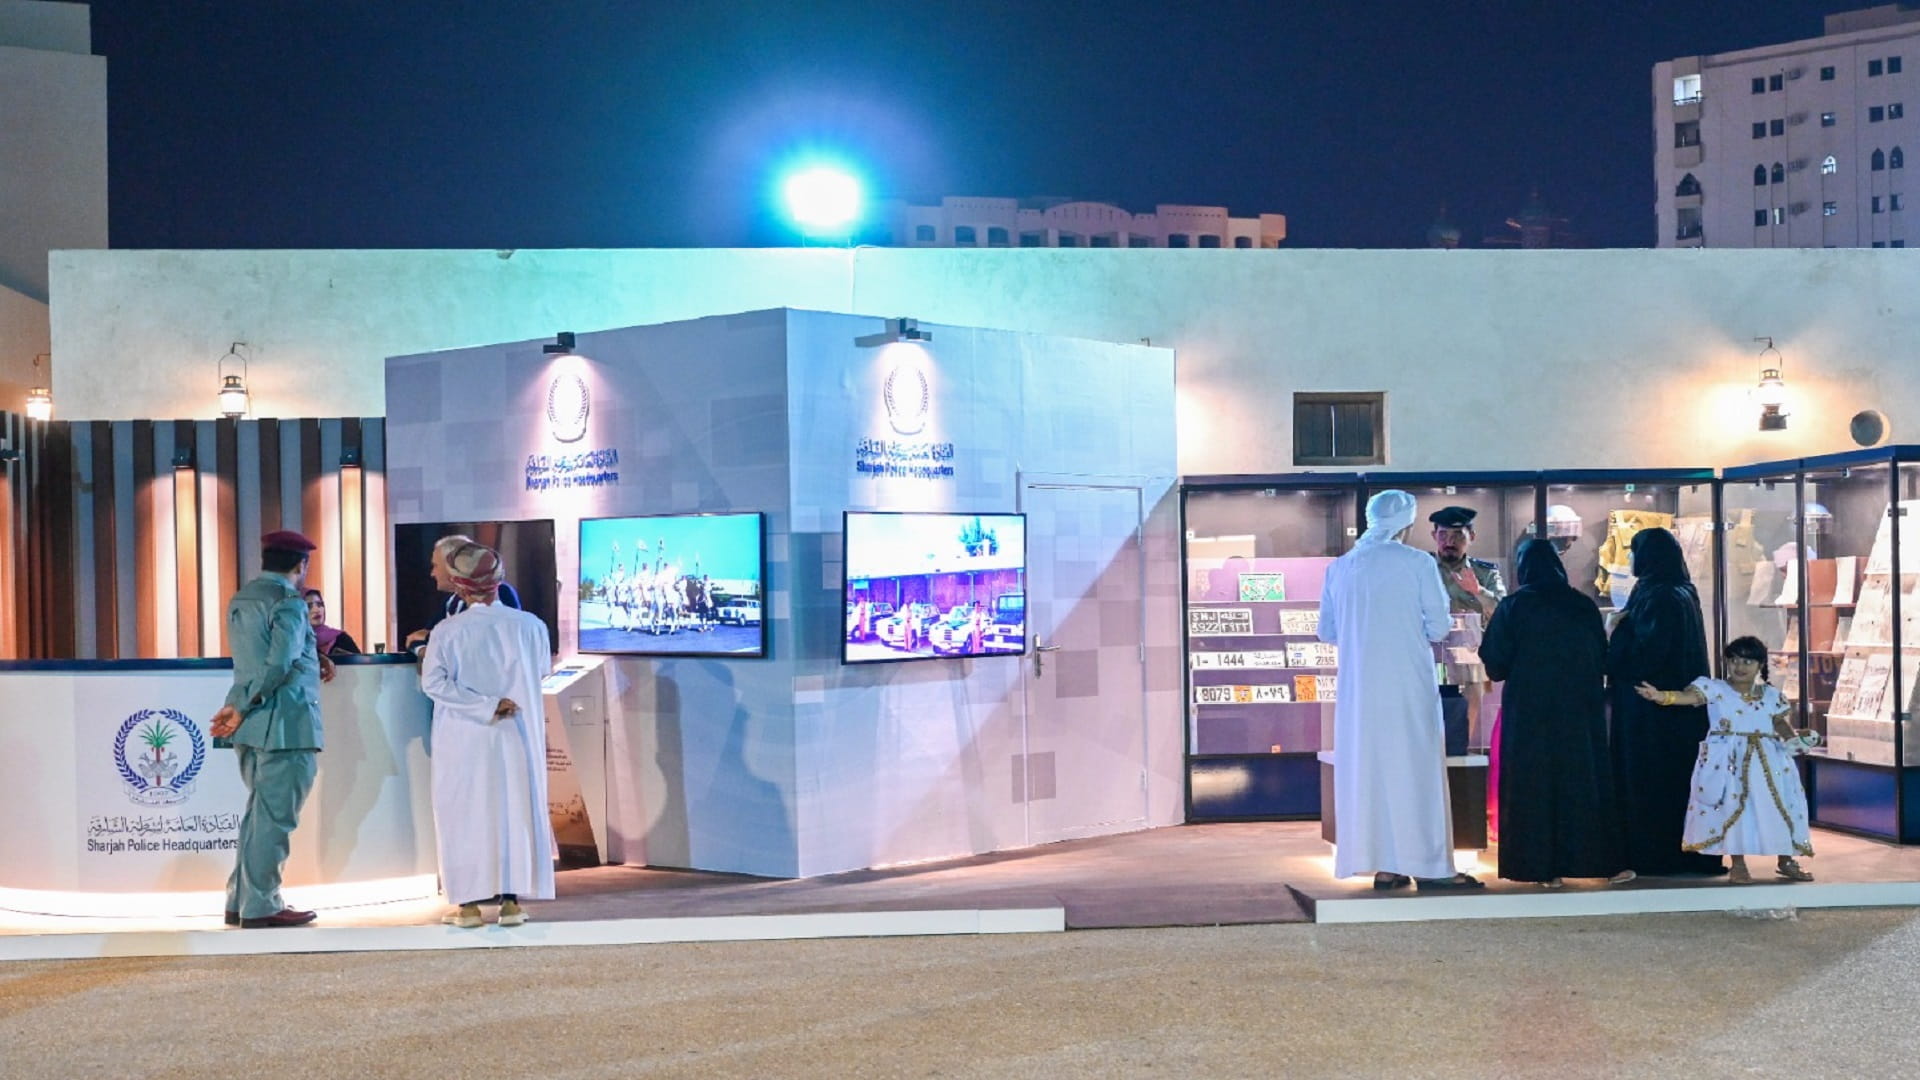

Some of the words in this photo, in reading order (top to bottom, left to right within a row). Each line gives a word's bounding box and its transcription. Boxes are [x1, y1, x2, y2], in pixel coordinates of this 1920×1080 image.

[1191, 612, 1217, 621] SHJ
[1217, 654, 1245, 666] 1444
[1201, 687, 1232, 701] 8079
[87, 838, 125, 855] Sharjah
[127, 838, 160, 851] Police
[162, 836, 239, 854] Headquarters
